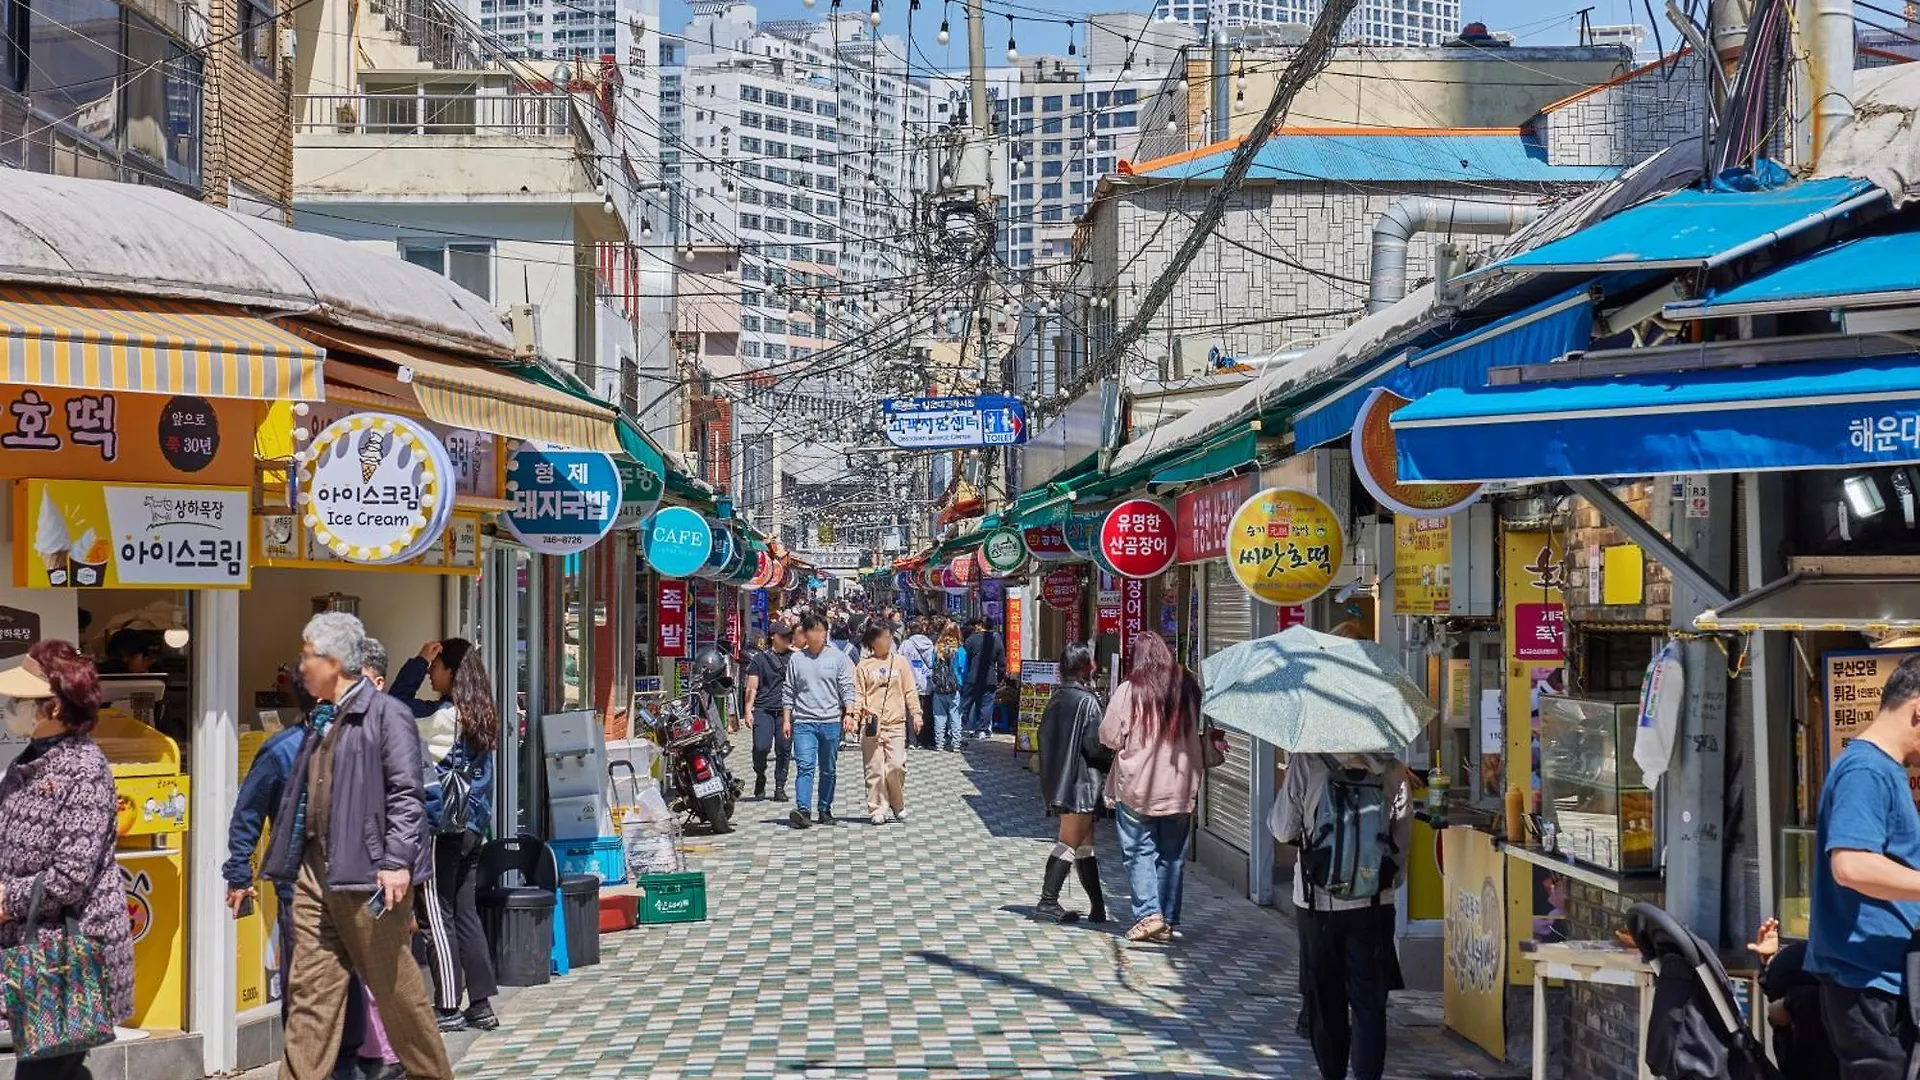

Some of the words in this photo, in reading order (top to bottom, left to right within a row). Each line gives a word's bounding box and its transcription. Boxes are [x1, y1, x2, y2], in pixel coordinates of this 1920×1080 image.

[171, 411, 207, 427] 앞으로
[183, 437, 212, 455] 30년
[986, 434, 1016, 443] TOILET
[318, 485, 420, 511] 아이스크림
[513, 490, 612, 521] 돼지국밥
[174, 500, 224, 519] 상하목장
[327, 511, 353, 526] Ice
[356, 511, 410, 527] Cream
[1116, 513, 1162, 534] 유명한
[652, 526, 704, 547] CAFE
[1108, 536, 1168, 557] 산곰장어
[121, 539, 242, 576] 아이스크림
[660, 589, 684, 648] 족발
[1833, 659, 1878, 678] 부산오뎅
[1833, 684, 1856, 702] 튀김
[1834, 708, 1856, 727] 튀김
